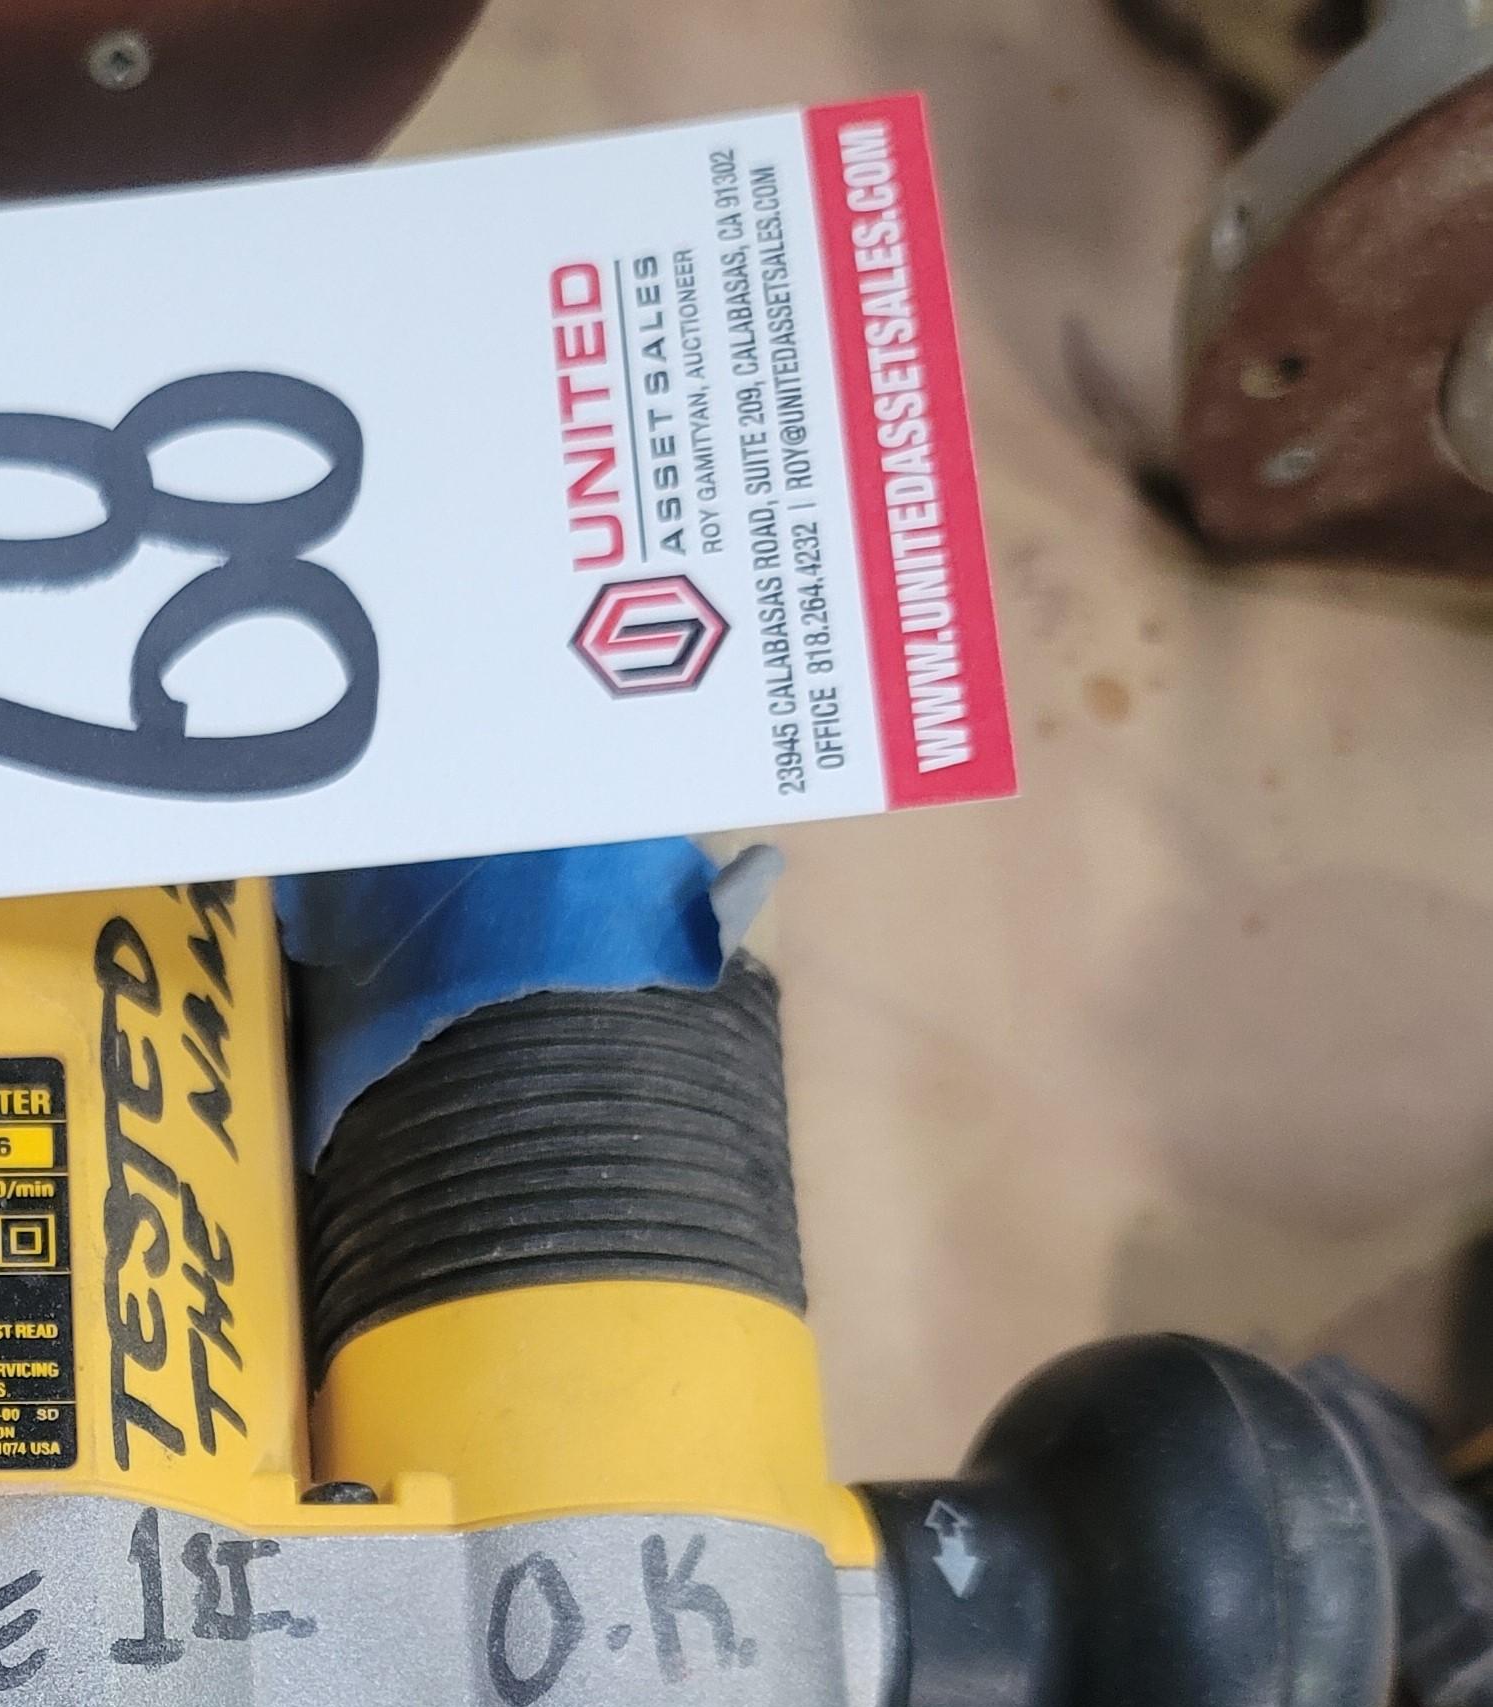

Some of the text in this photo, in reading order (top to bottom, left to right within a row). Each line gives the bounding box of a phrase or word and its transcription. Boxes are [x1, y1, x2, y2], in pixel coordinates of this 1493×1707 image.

[550, 262, 627, 571] UNITED
[634, 255, 686, 553] ASSET SALES
[673, 248, 723, 553] ROY GAMITYAN, AUCTIONEER
[710, 148, 806, 794] 23945 CALABASAS ROAD, SUITE 209, CALABASAS, CA 91302
[751, 166, 845, 768] OFFICE 818.264.4232 ROY@UNITEDASSETSALES.COM
[839, 122, 971, 772] WWW.UNITEDASSETSALES.COM
[15, 1323, 59, 1340] READ
[94, 914, 187, 1472] TESTED
[180, 1181, 248, 1458] THE
[29, 1441, 62, 1456] USA
[486, 1531, 758, 1707] O.K.
